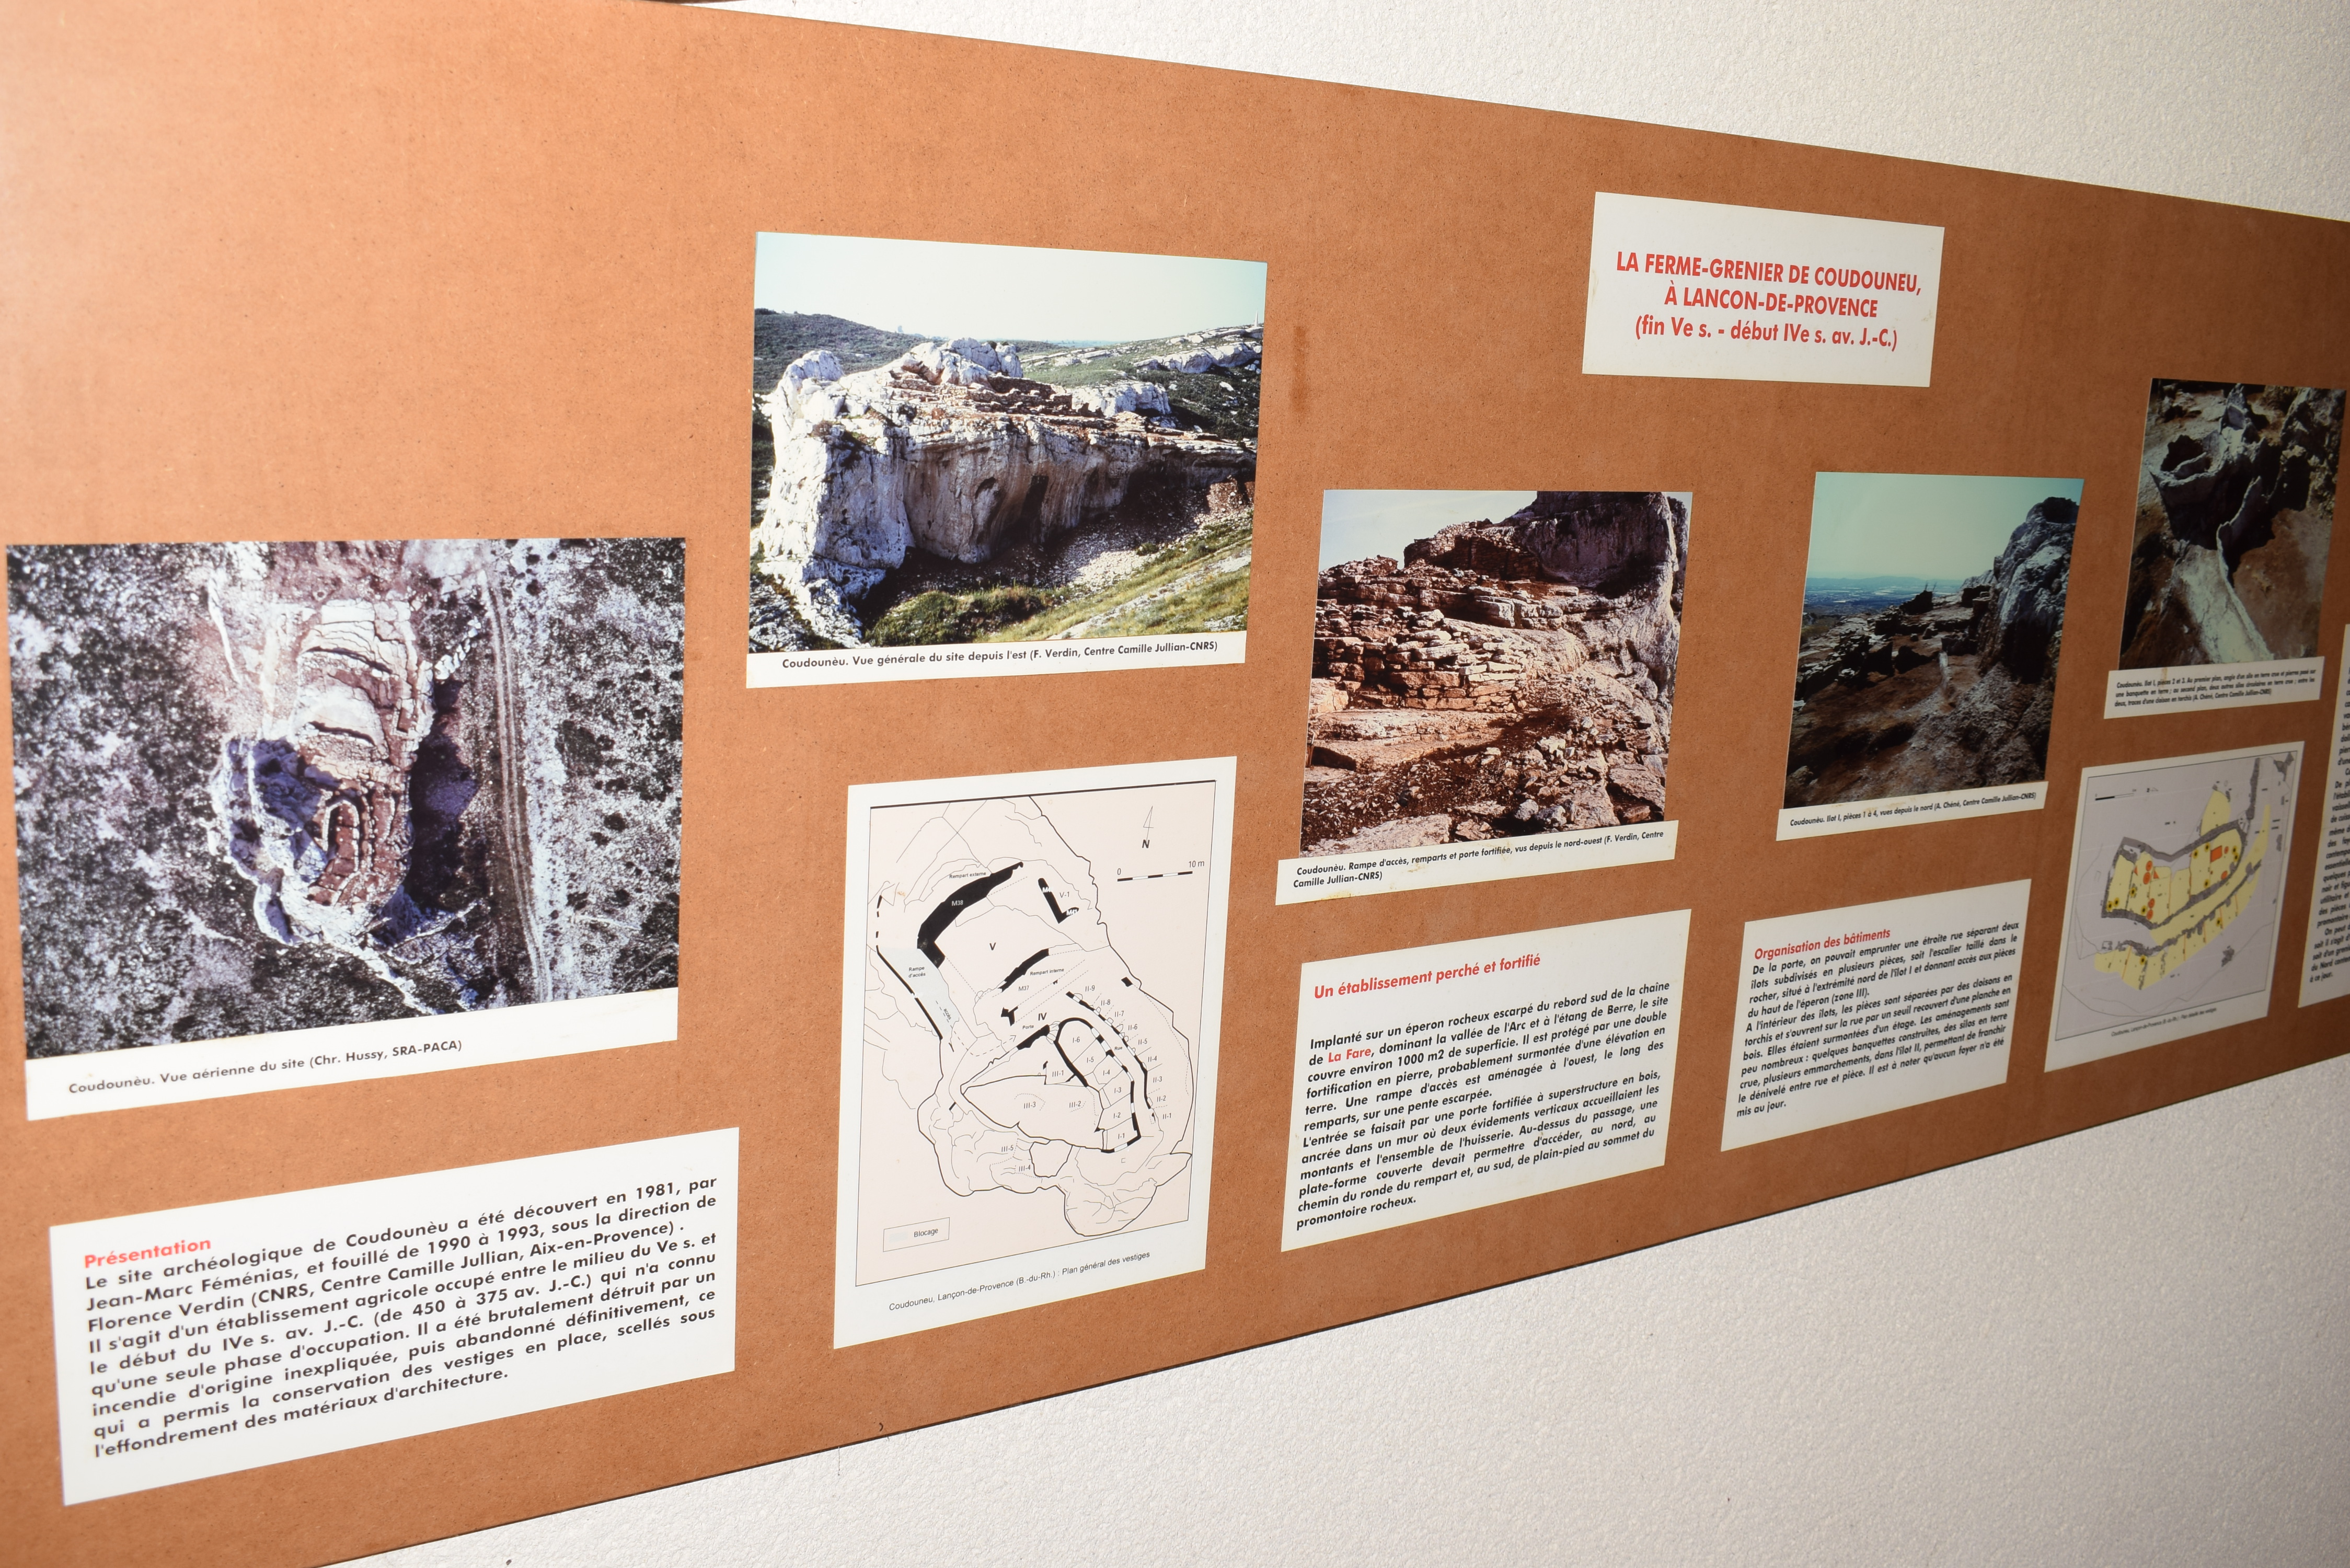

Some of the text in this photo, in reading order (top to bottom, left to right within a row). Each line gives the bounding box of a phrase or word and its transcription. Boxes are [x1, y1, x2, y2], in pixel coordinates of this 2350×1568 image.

[1616, 251, 1921, 296] LA FERME-GRENIER DE COUDOUNEU,
[1664, 279, 1878, 318] À LANCON-DE-PROVENCE
[1635, 314, 1665, 340] (fin
[1671, 316, 1694, 337] Ve
[1698, 323, 1711, 338] s.
[1730, 319, 1779, 341] début
[1783, 322, 1810, 343] IVe
[1814, 330, 1826, 344] s.
[1831, 331, 1854, 345] av.
[1859, 327, 1897, 352] J.-C.)
[782, 641, 1218, 668] Coudounèu. Vue générale du site depuis l'est (F. Verdin, Centre Camille Jullian-CNRS)
[1790, 816, 1825, 827] Coudounèu.
[1842, 813, 1862, 822] pièces
[1893, 805, 1913, 815] depuis
[1919, 803, 1933, 811] nord
[1933, 802, 1942, 811] (A.
[1296, 863, 1346, 876] Coudounèu.
[1348, 861, 1377, 871] Rampe
[1379, 857, 1409, 867] d'accès,
[1411, 853, 1447, 864] remparts
[1458, 850, 1480, 861] porte
[1481, 846, 1513, 857] fortifiée,
[1529, 841, 1553, 852] depuis
[1555, 840, 1562, 848] le
[1563, 837, 1603, 848] nord-ouest
[1604, 835, 1612, 845] (F.
[1614, 833, 1640, 842] Verdin,
[1641, 831, 1664, 839] Centre
[1293, 871, 1383, 888] Camille Jullian-CNRS)
[1752, 921, 2019, 975] De la porte, on pouvait emprunter une étroite rue séparant deux
[1754, 929, 1891, 961] Organisation des bâtiments
[1314, 953, 1541, 999] Un établissement perché et fortifié
[1038, 1012, 1047, 1021] IV
[1310, 982, 1670, 1051] Implanté sur un éperon rocheux escarpé du rebord sud de la chaîne
[68, 1040, 462, 1094] Coudounèu. Vue aérienne du site (Chr. Hussy, SRA-PACA)
[86, 1178, 717, 1290] Le site archéologique de Coudounèu a été découvert en 1981, par
[914, 1227, 939, 1239] Blocage
[85, 1240, 211, 1269] Présentation
[889, 1295, 935, 1311] Coudouneu,
[937, 1278, 1014, 1301] Lançon-de-Provence
[1062, 1266, 1078, 1276] Plan
[1079, 1259, 1106, 1272] général
[1108, 1256, 1121, 1266] des
[1122, 1251, 1150, 1264] vestiges
